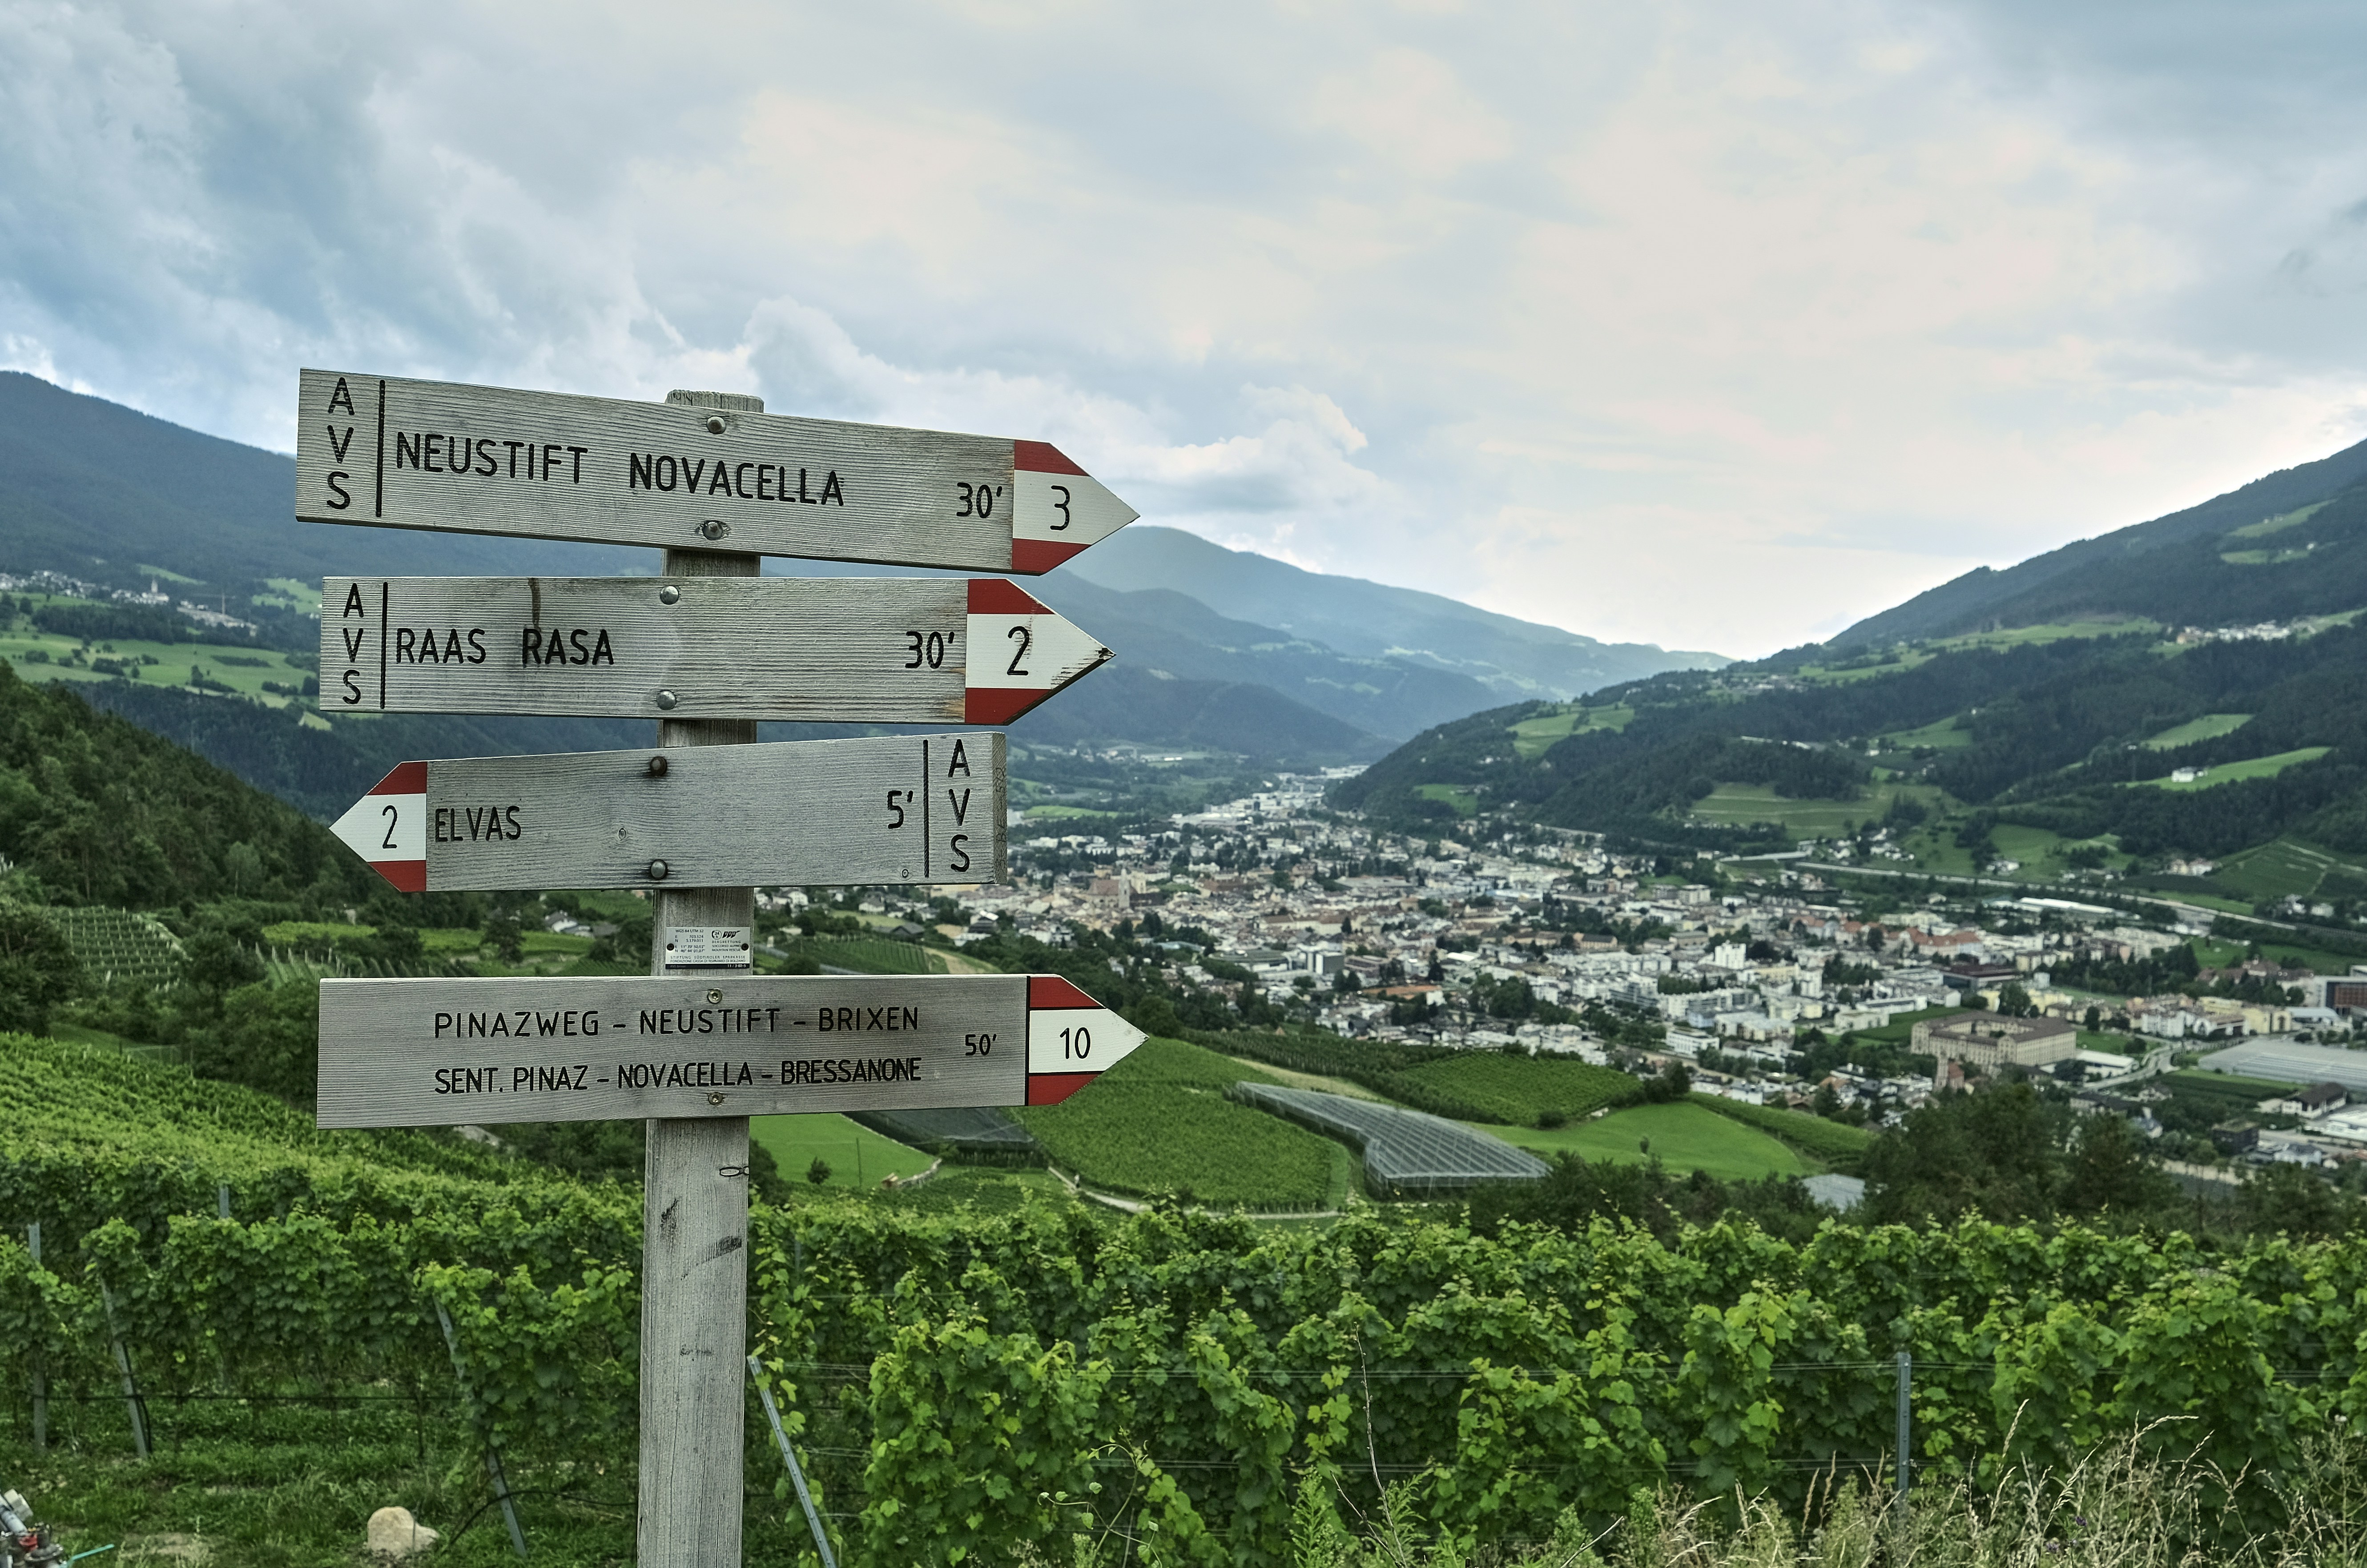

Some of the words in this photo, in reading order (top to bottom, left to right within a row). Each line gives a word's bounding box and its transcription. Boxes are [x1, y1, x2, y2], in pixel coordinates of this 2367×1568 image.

[396, 431, 588, 484] NEUSTIFT
[629, 452, 847, 507] NOVACELLA
[956, 482, 1002, 519] 30'
[1050, 485, 1070, 531] 3
[396, 627, 486, 664] RAAS
[522, 627, 615, 666] RASA
[905, 631, 955, 670] 30'
[1006, 626, 1030, 676] 2
[382, 805, 398, 849] 2
[435, 805, 521, 843] ELVAS
[887, 790, 914, 829] 5'
[435, 1010, 598, 1038] PINAZWEG
[640, 1008, 781, 1034] NEUSTIFT
[818, 1006, 918, 1033] BRIXEN
[965, 1033, 997, 1056] 50'
[1059, 1027, 1091, 1059] 10
[435, 1067, 503, 1094] SENT.
[513, 1065, 588, 1092] PINAZ
[618, 1061, 753, 1089] NOVACELLA
[781, 1057, 922, 1085] BRESSANONE
